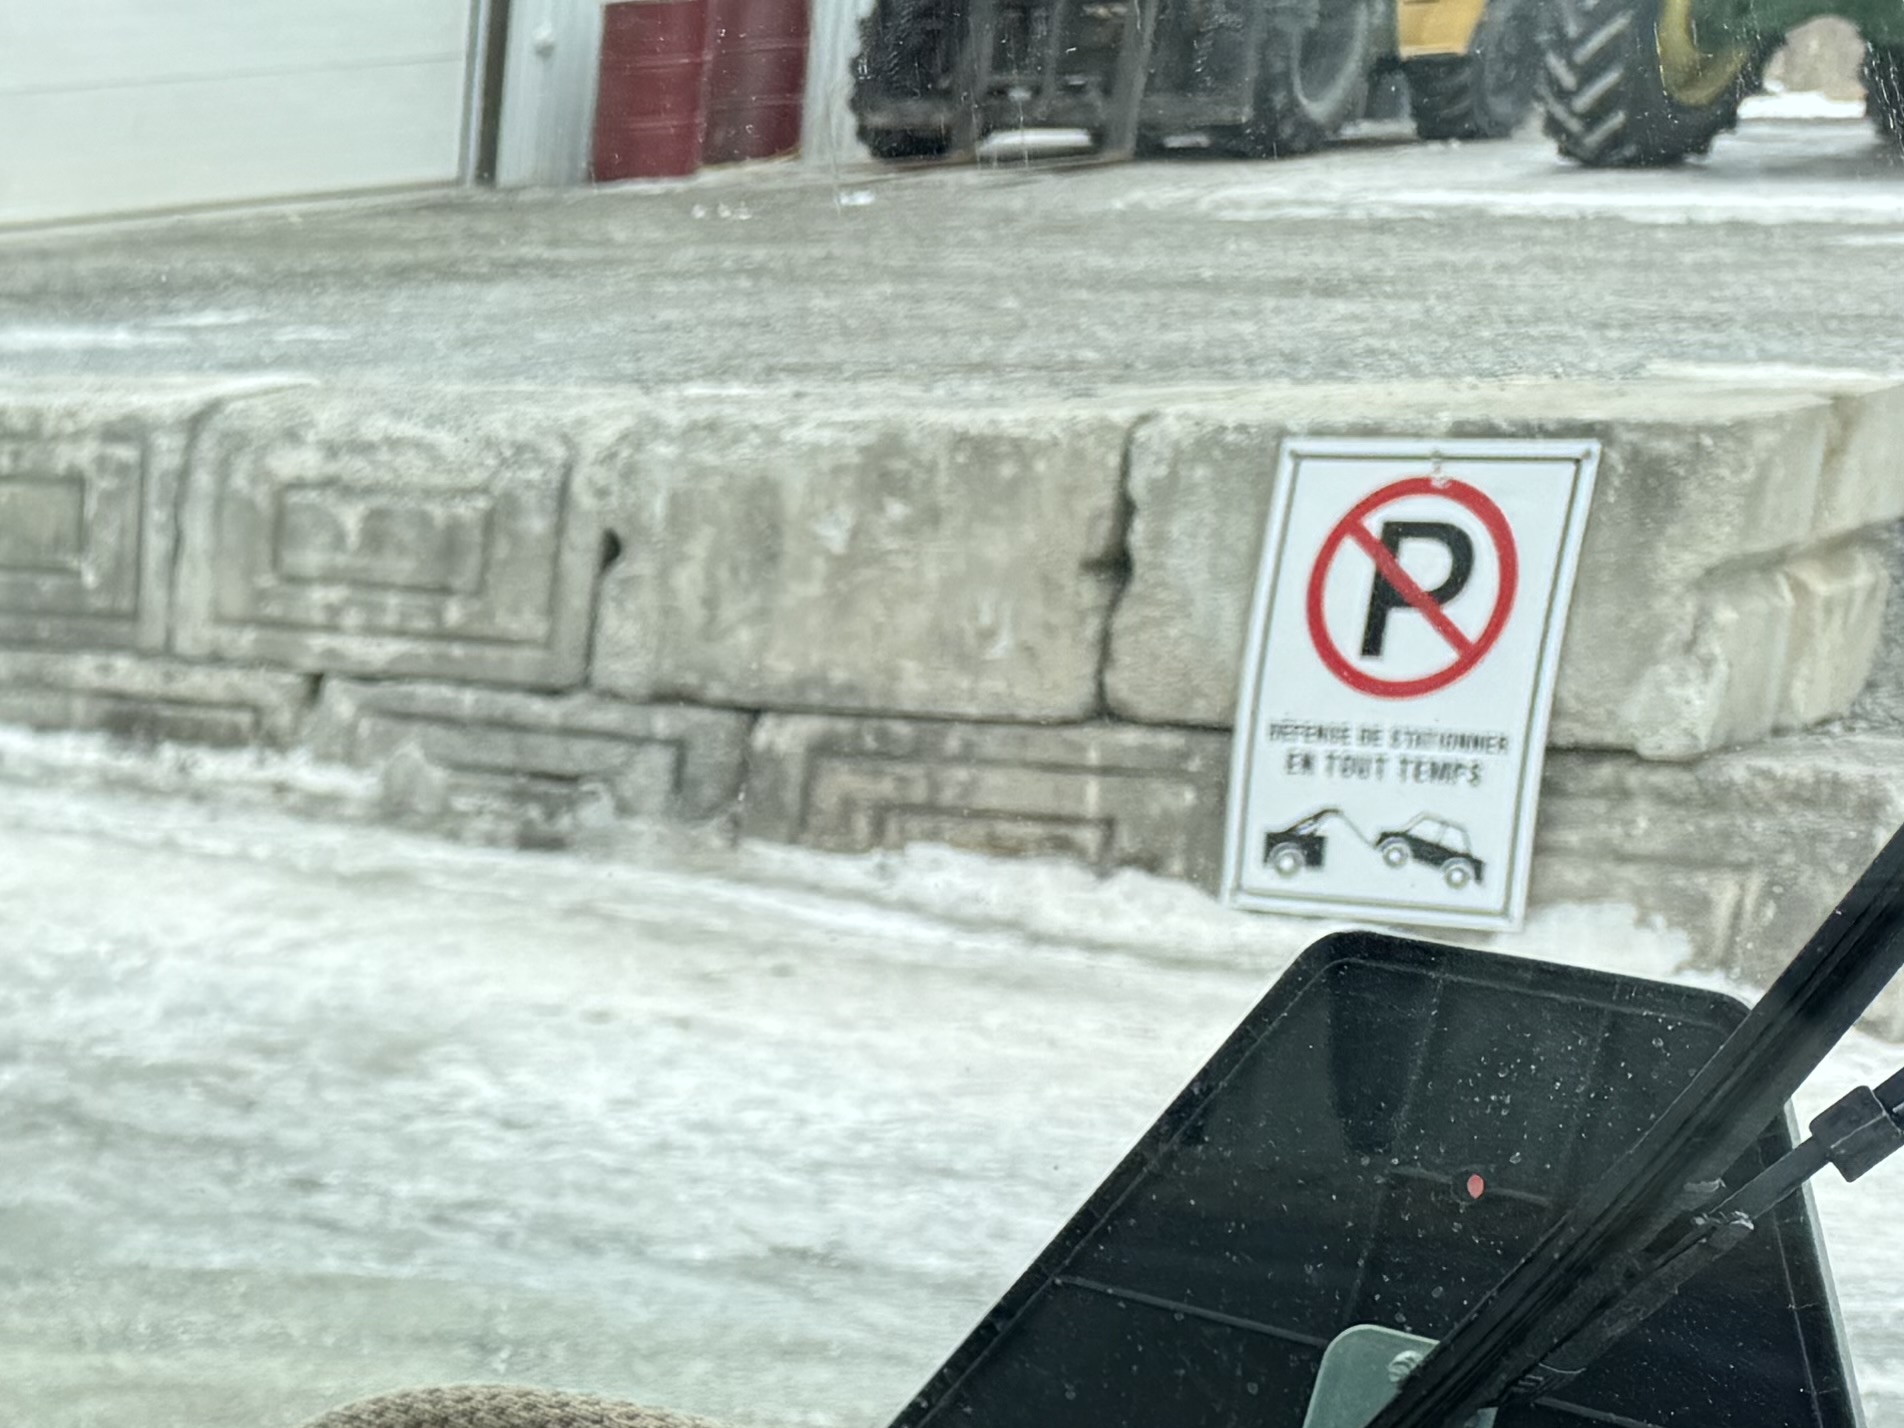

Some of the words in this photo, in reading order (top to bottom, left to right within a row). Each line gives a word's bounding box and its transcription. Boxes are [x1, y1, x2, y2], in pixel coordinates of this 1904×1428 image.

[1360, 721, 1384, 748] DE
[1389, 724, 1509, 755] STATIONNER
[1285, 751, 1316, 776] EN
[1323, 752, 1388, 781] TOUT
[1398, 756, 1482, 788] TEMPS
